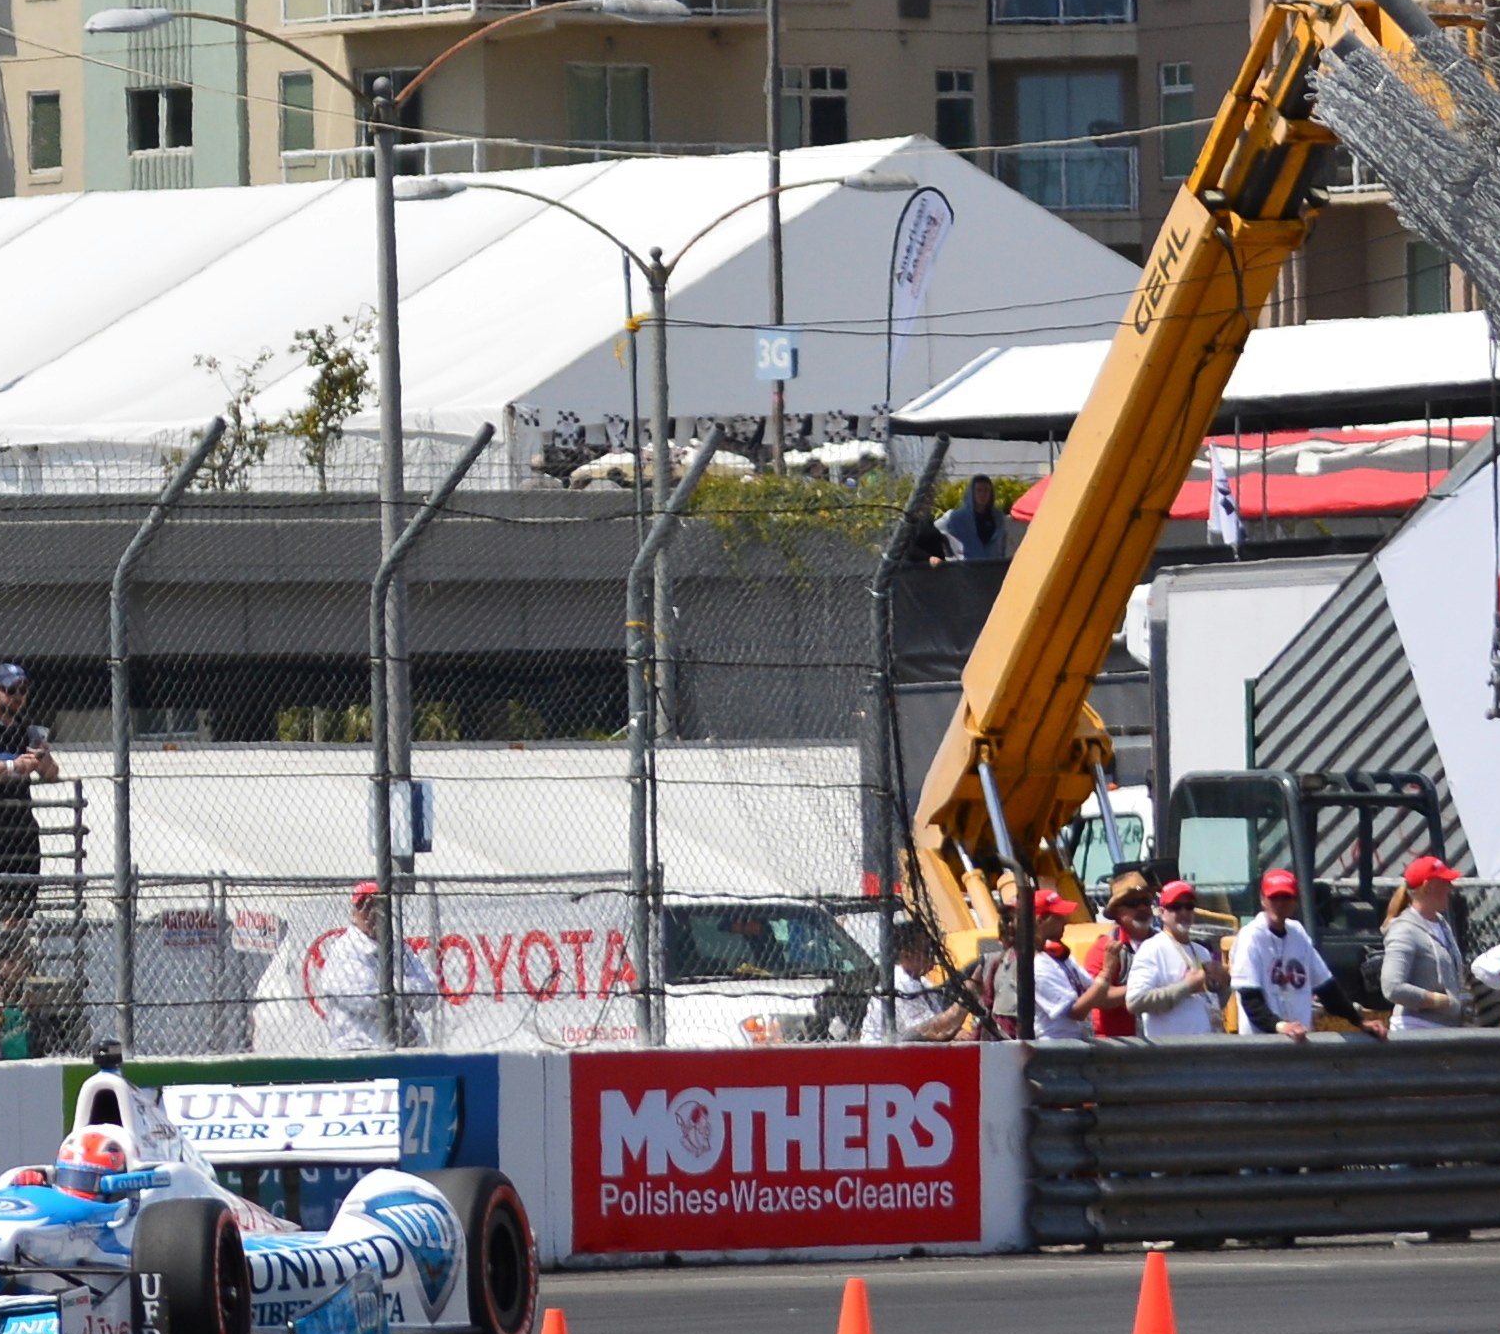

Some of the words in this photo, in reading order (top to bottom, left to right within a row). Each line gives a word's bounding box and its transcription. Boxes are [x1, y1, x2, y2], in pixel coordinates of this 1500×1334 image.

[1135, 227, 1190, 334] GEHL
[758, 337, 789, 368] 3G
[162, 909, 217, 929] NATIONAL
[404, 1084, 435, 1154] 27
[601, 1080, 954, 1178] MOTHERS
[376, 1202, 453, 1250] UFD
[248, 1235, 405, 1295] UNITED
